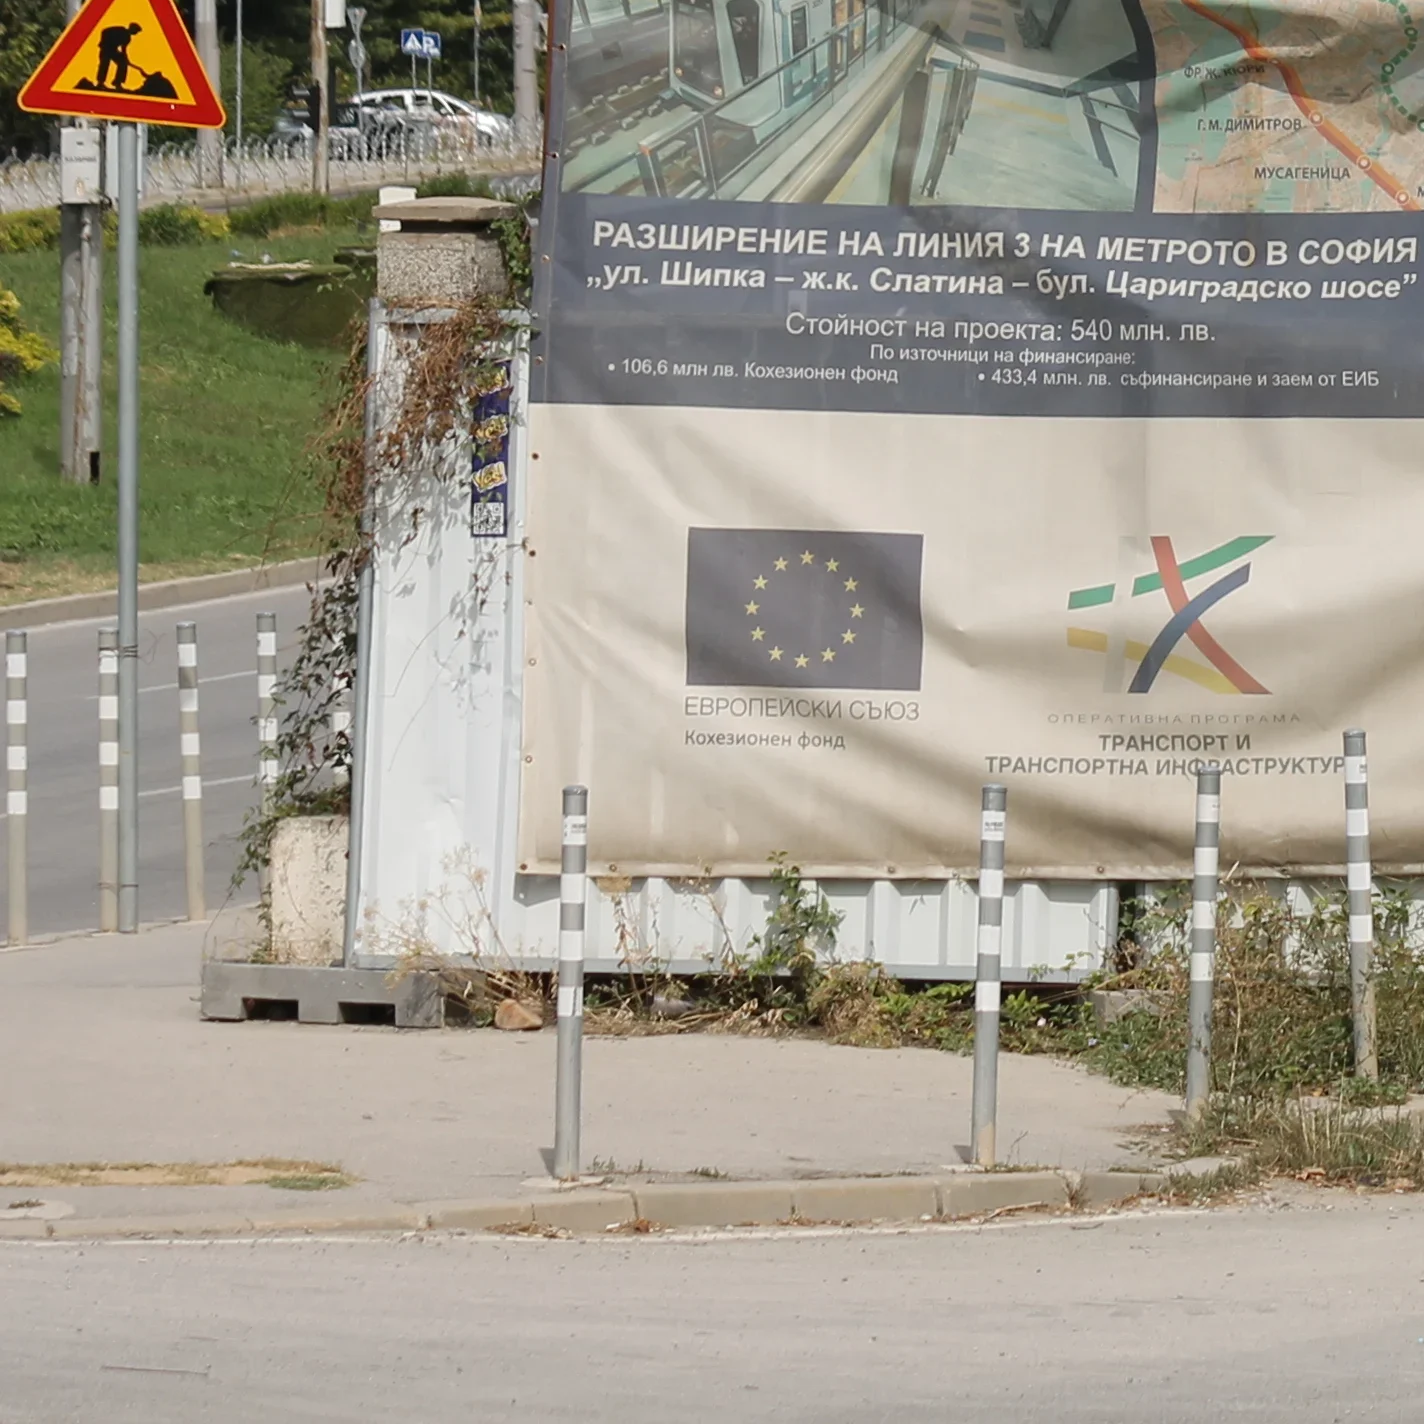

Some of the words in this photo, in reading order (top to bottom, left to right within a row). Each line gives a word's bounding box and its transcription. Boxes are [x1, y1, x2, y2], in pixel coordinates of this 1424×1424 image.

[1197, 120, 1206, 131] Г.
[1209, 120, 1222, 131] М.
[1224, 118, 1303, 132] ДИМИТРОВ
[1254, 167, 1351, 181] МУСАГЕНИЦА
[593, 220, 828, 255] РАЗШИРЕНИЕ
[838, 230, 884, 256] НА
[893, 232, 1004, 258] ЛИНИЯ
[1013, 233, 1030, 258] 3
[1040, 234, 1086, 259] НА
[1096, 237, 1256, 267] МЕТРОТО
[1266, 241, 1288, 266] В
[1299, 237, 1417, 265] СОФИЯ
[661, 260, 765, 288] Шипка
[801, 270, 858, 290] ж.к.
[870, 267, 1004, 295] Слатина
[1037, 268, 1095, 300] бул.
[1106, 270, 1311, 303] Цариградско
[786, 311, 907, 338] Стойност
[915, 320, 945, 338] на
[954, 322, 1062, 343] проекта:
[1071, 319, 1112, 341] 540
[870, 344, 894, 360] По
[900, 348, 988, 364] източници
[994, 349, 1015, 362] на
[1019, 348, 1135, 367] финансиране:
[622, 358, 668, 376] 106,6
[673, 363, 708, 376] млн
[712, 364, 738, 377] лв.
[744, 362, 846, 380] Кохезионен
[850, 366, 898, 384] фонд
[991, 369, 1037, 387] 433,4
[1043, 373, 1082, 386] млн.
[1087, 373, 1111, 386] лв.
[1120, 371, 1252, 389] съфинансиране
[1257, 375, 1267, 386] и
[1272, 375, 1313, 386] заем
[1318, 375, 1336, 386] от
[1342, 371, 1379, 387] ЕИБ
[684, 695, 842, 718] ЕВРОПЕЙСКИ
[849, 700, 920, 721] СЪЮЗ
[1048, 712, 1182, 724] ОПЕРАТИВНА
[1190, 712, 1301, 725] ПРОГРАМА
[684, 729, 791, 747] Кохезионен
[797, 732, 846, 750] фонд
[1099, 734, 1229, 752] ТРАНСПОРТ
[1236, 734, 1251, 750] И
[985, 756, 1149, 776] ТРАНСПОРТНА
[1156, 756, 1344, 776] ИНФРАСТРУКТУР
